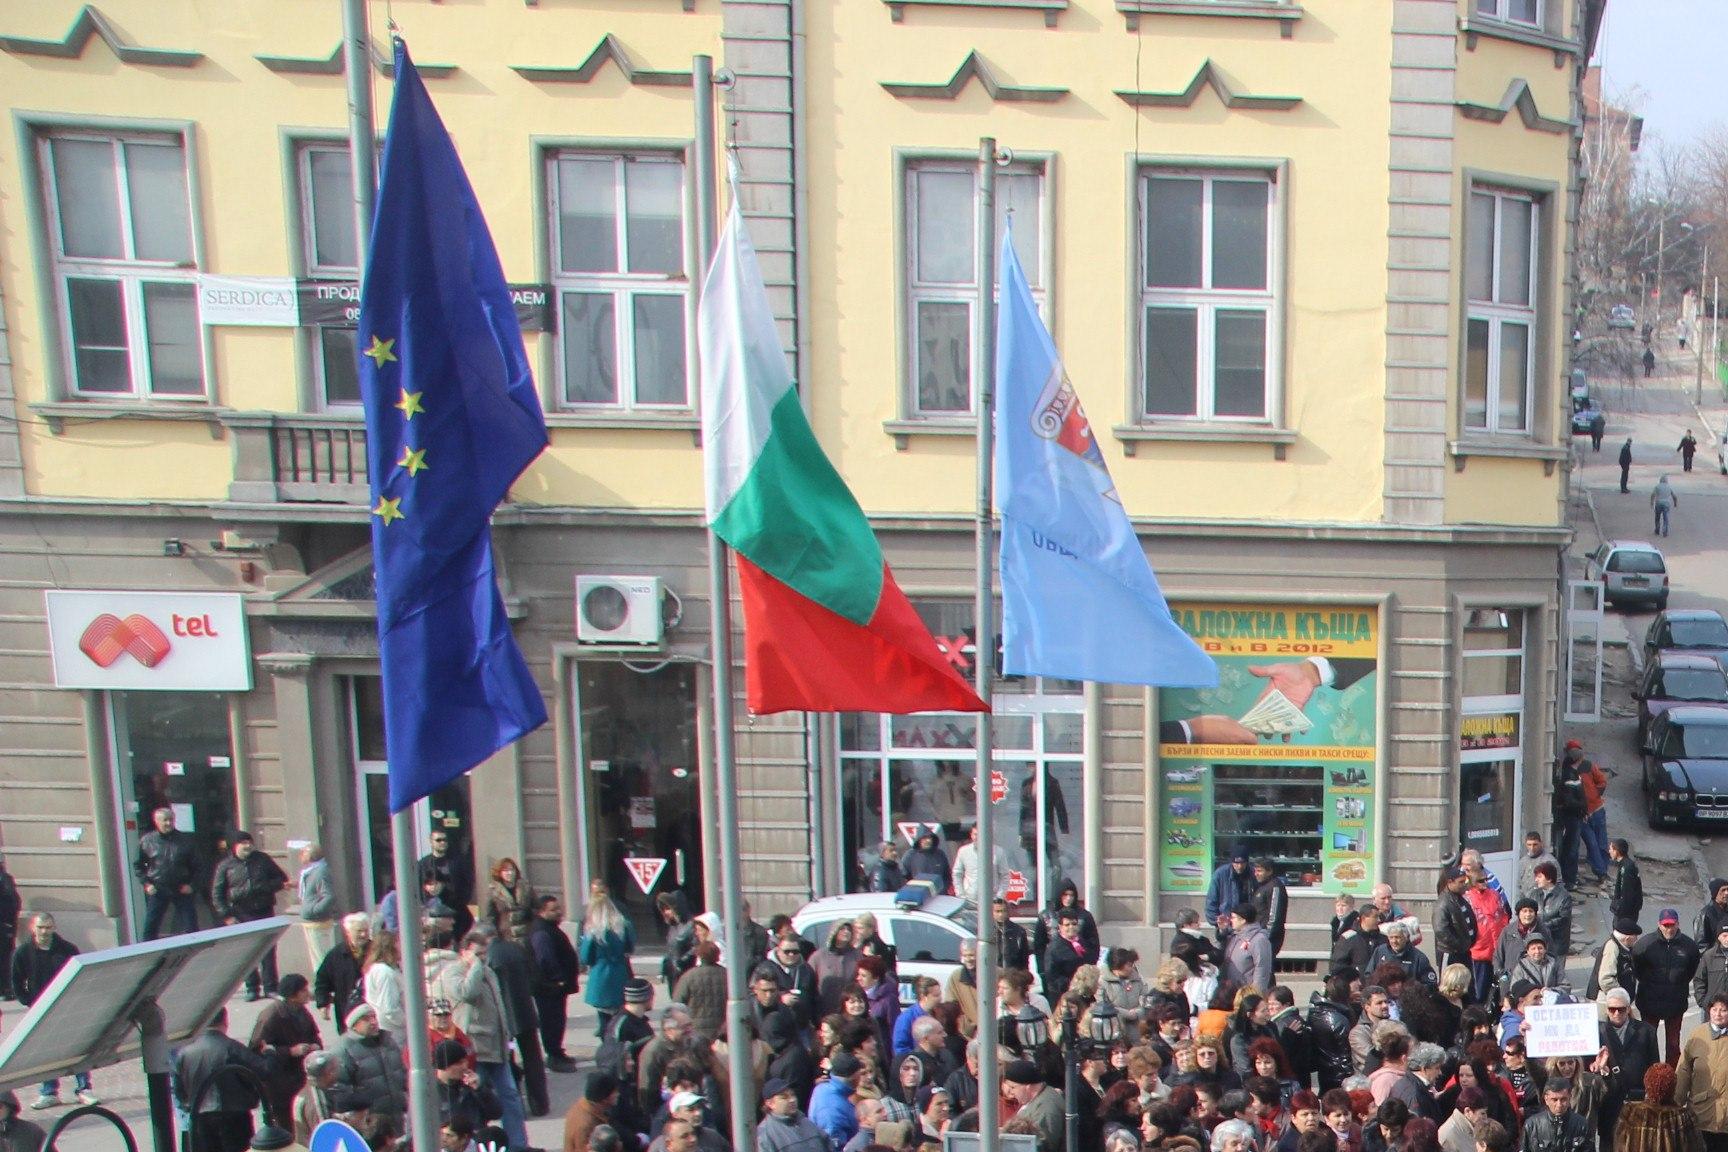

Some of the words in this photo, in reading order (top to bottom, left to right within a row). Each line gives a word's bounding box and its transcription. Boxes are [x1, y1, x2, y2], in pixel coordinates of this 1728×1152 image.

[207, 289, 288, 306] SERDICA
[317, 286, 360, 301] ПРОД
[172, 613, 218, 637] tel
[1295, 611, 1371, 644] КЪЩА
[1277, 643, 1333, 653] 2012
[1259, 747, 1284, 757] НИСКИ
